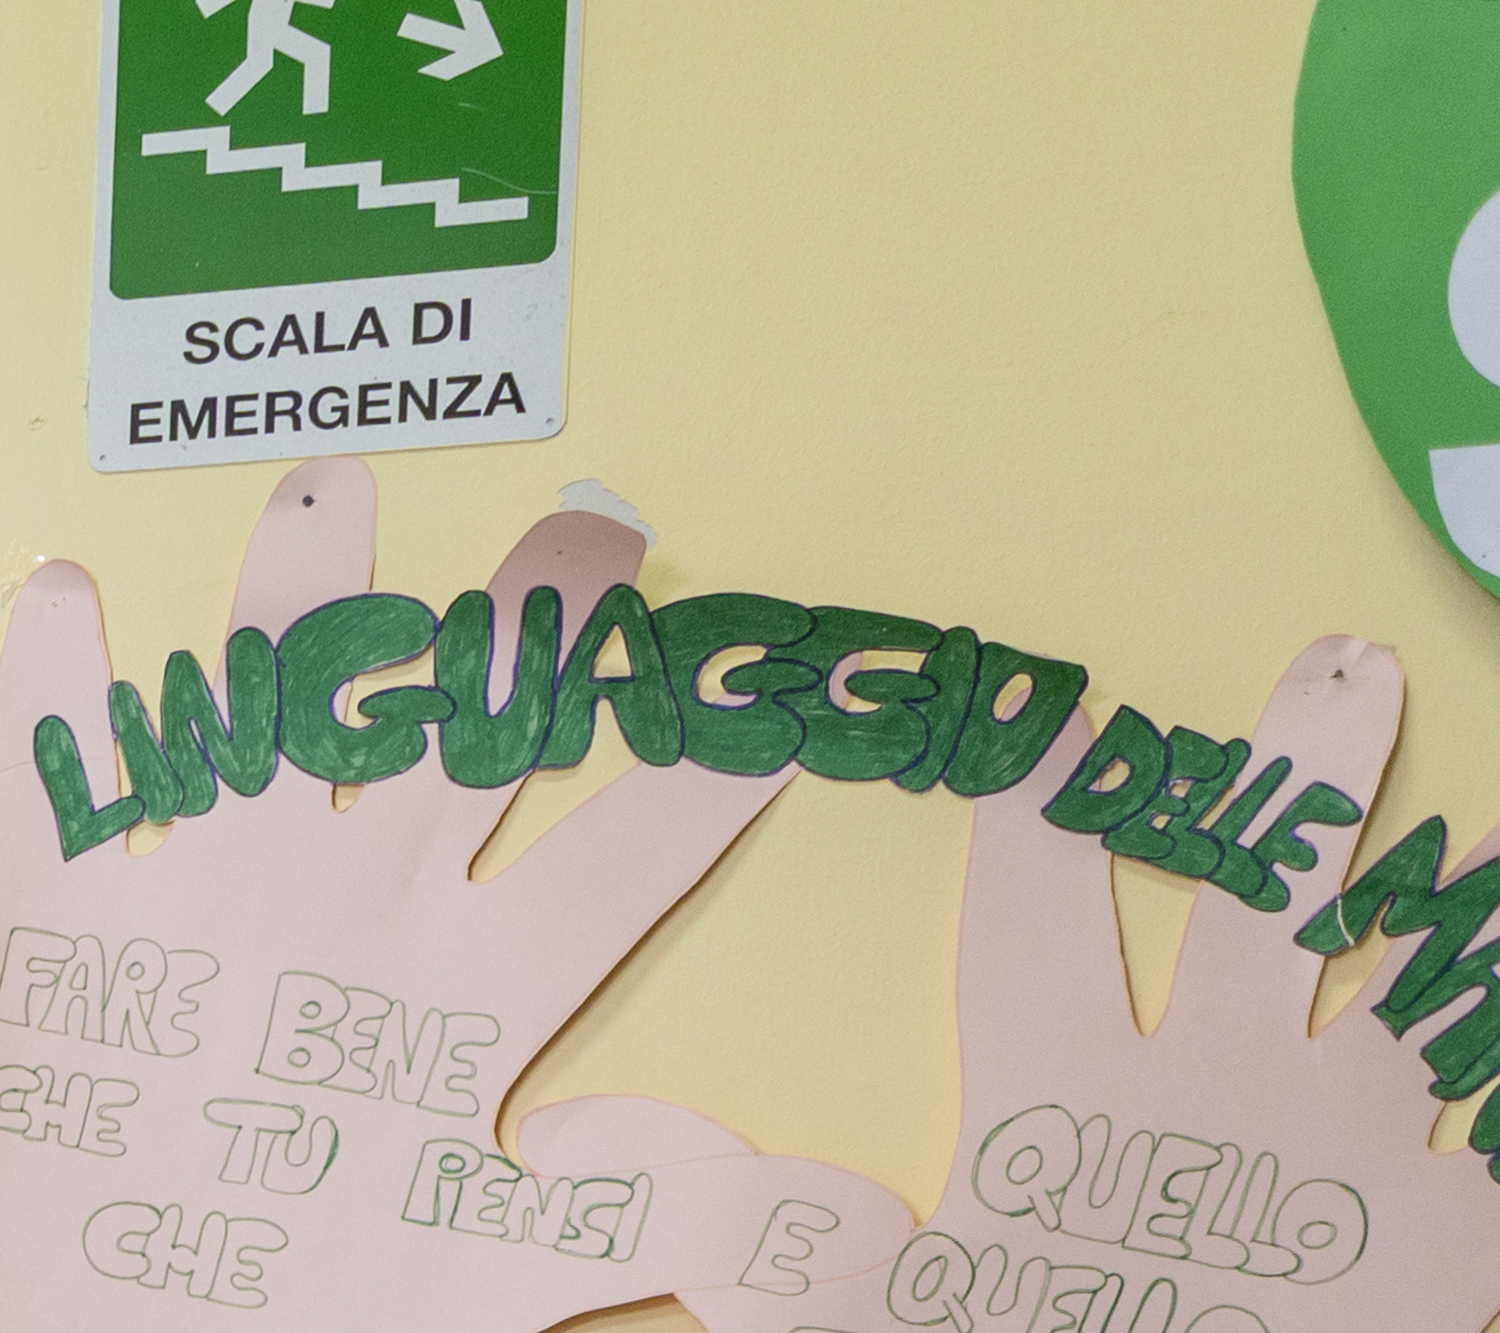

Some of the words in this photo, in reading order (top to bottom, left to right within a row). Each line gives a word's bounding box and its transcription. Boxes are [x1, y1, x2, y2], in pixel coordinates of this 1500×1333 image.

[182, 306, 389, 365] SCALA
[411, 298, 472, 345] DI
[128, 372, 527, 446] EMERGENZA
[33, 583, 1089, 862] LINGUAGGIO
[1040, 703, 1364, 913] DELLE
[254, 970, 501, 1118] BENE
[202, 1097, 340, 1196] TU
[401, 1138, 653, 1263] PENSI
[971, 1103, 1369, 1285] QUELLO
[82, 1201, 289, 1310] CHE
[738, 1199, 841, 1297] E
